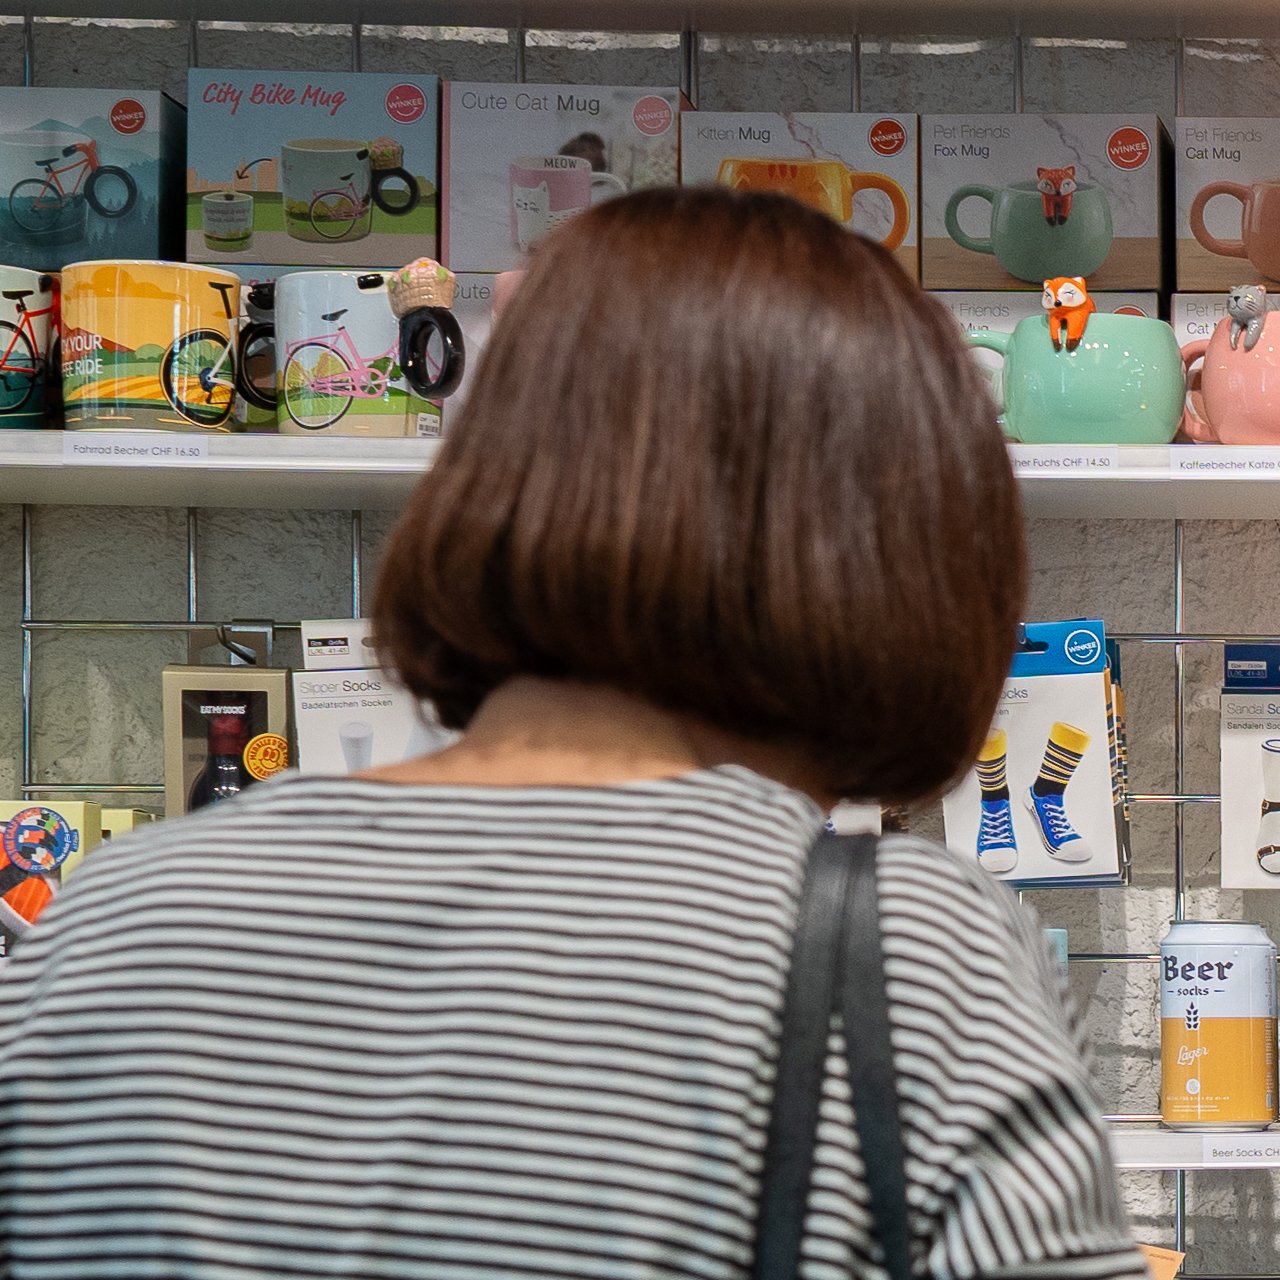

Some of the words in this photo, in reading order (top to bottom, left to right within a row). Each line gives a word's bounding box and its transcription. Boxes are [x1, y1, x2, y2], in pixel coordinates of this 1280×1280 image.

[203, 82, 243, 115] City
[250, 84, 296, 104] Bike
[300, 85, 347, 116] Mug
[461, 92, 507, 110] Cute
[515, 93, 548, 110] Cat
[557, 95, 600, 115] Mug
[697, 126, 734, 141] Kitten
[738, 126, 771, 144] Mug
[933, 125, 959, 139] Pet
[963, 124, 1010, 139] Friends
[1186, 128, 1208, 142] Pet
[1212, 128, 1262, 143] Friends
[934, 144, 959, 157] Fox
[963, 144, 990, 159] Mug
[1109, 141, 1148, 155] WINKEE
[1186, 145, 1209, 160] Cat
[1212, 146, 1241, 163] Mug
[544, 157, 577, 169] MEOW
[1186, 304, 1208, 318] Pet
[71, 335, 102, 352] YOUR
[75, 359, 102, 375] RIDE
[73, 445, 111, 456] Fahrrad
[114, 445, 149, 457] Becher
[151, 447, 172, 457] CHF
[175, 447, 200, 457] 16.50
[1033, 457, 1060, 468] Fuchs
[1063, 457, 1082, 468] CHF
[1085, 457, 1110, 467] 14.50
[1179, 459, 1246, 470] Kaffeebecher
[1248, 459, 1275, 470] Katze
[342, 680, 381, 692] Socks
[302, 700, 358, 709] Badelatschen
[361, 699, 393, 708] Socken
[1226, 703, 1264, 716] Sandal
[1163, 955, 1234, 982] Beer
[1177, 987, 1209, 996] socks
[1177, 1045, 1209, 1066] Lager
[1212, 1148, 1234, 1157] Beer
[1236, 1147, 1262, 1157] Socks
